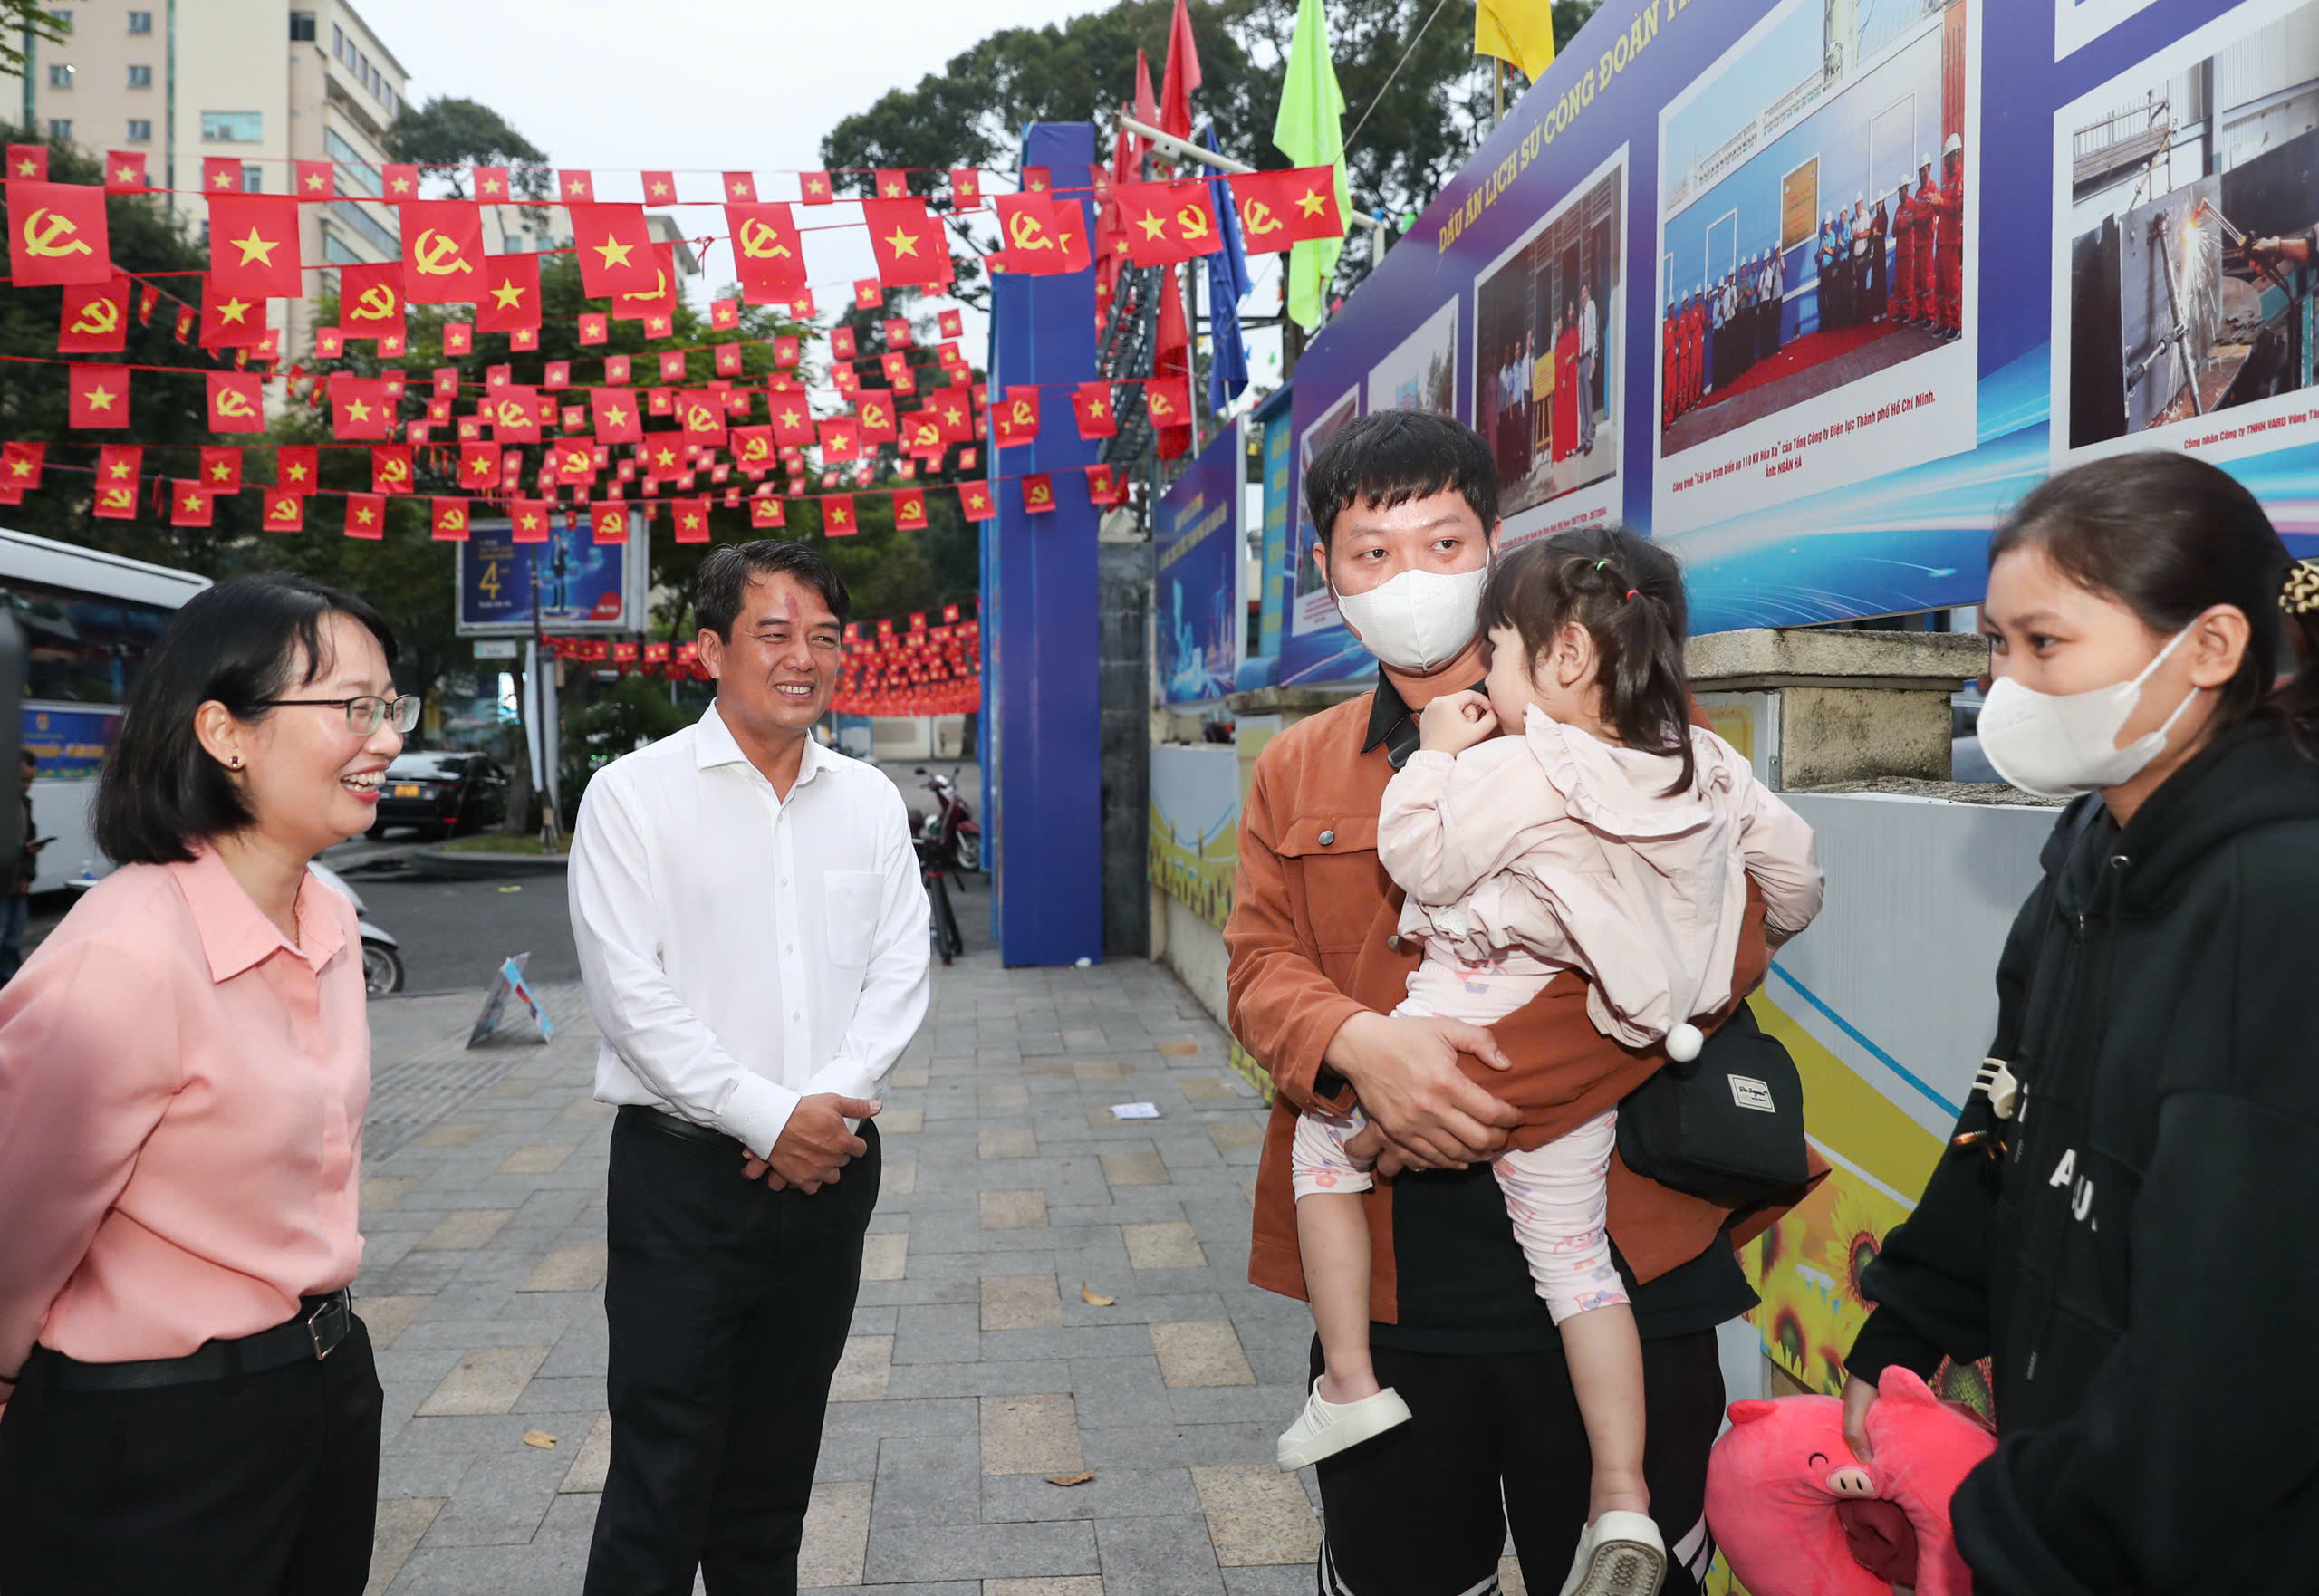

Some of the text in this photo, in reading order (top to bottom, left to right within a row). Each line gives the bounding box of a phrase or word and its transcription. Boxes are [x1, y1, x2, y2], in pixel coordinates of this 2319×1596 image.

[1485, 149, 1517, 208] LỊCH
[1544, 67, 1595, 145] CÔNG
[1599, 0, 1660, 92] ĐOÀN
[1742, 455, 1752, 467] 110
[1794, 435, 1806, 449] Tổng
[1807, 430, 1822, 445] Công
[1823, 428, 1829, 440] ty
[1830, 422, 1843, 438] Điện
[1845, 418, 1855, 434] lực
[1856, 411, 1876, 428] Thành
[1877, 403, 1890, 422] phố
[1891, 400, 1900, 417] Hồ
[1901, 397, 1914, 413] Chí
[1915, 390, 1936, 408] Minh.
[2184, 437, 2200, 449] Công
[2219, 429, 2237, 441] Công
[2238, 428, 2245, 437] ty
[2267, 417, 2286, 429] VARD
[2288, 411, 2306, 424] Vũng
[479, 561, 501, 600] 4
